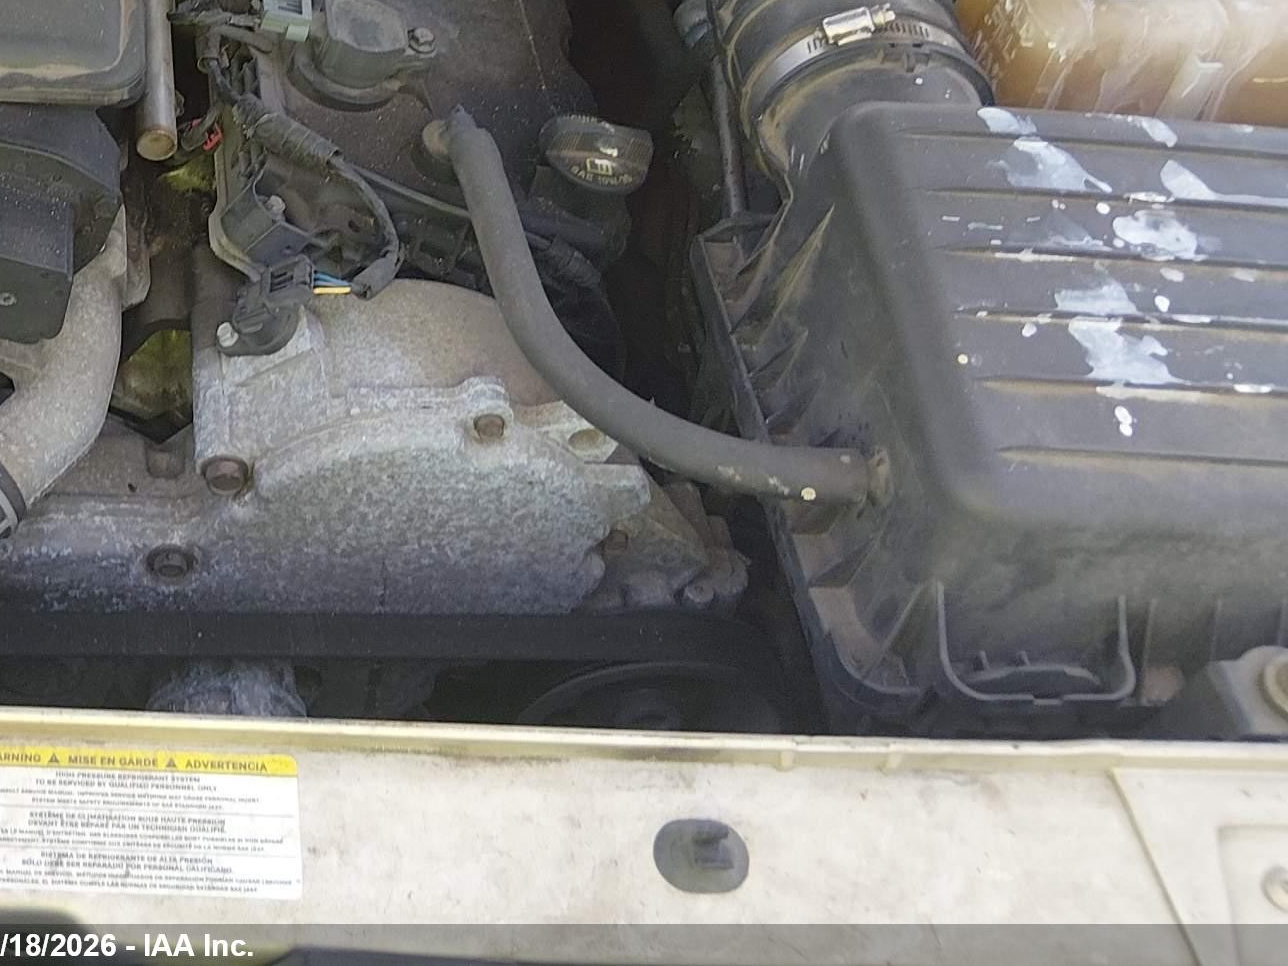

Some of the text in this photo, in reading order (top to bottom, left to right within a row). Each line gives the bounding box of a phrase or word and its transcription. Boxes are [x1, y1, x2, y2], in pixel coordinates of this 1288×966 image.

[69, 753, 96, 765] MISE
[101, 755, 116, 765] EN
[119, 756, 159, 767] GARDE
[185, 759, 269, 772] ADVERTENCIA
